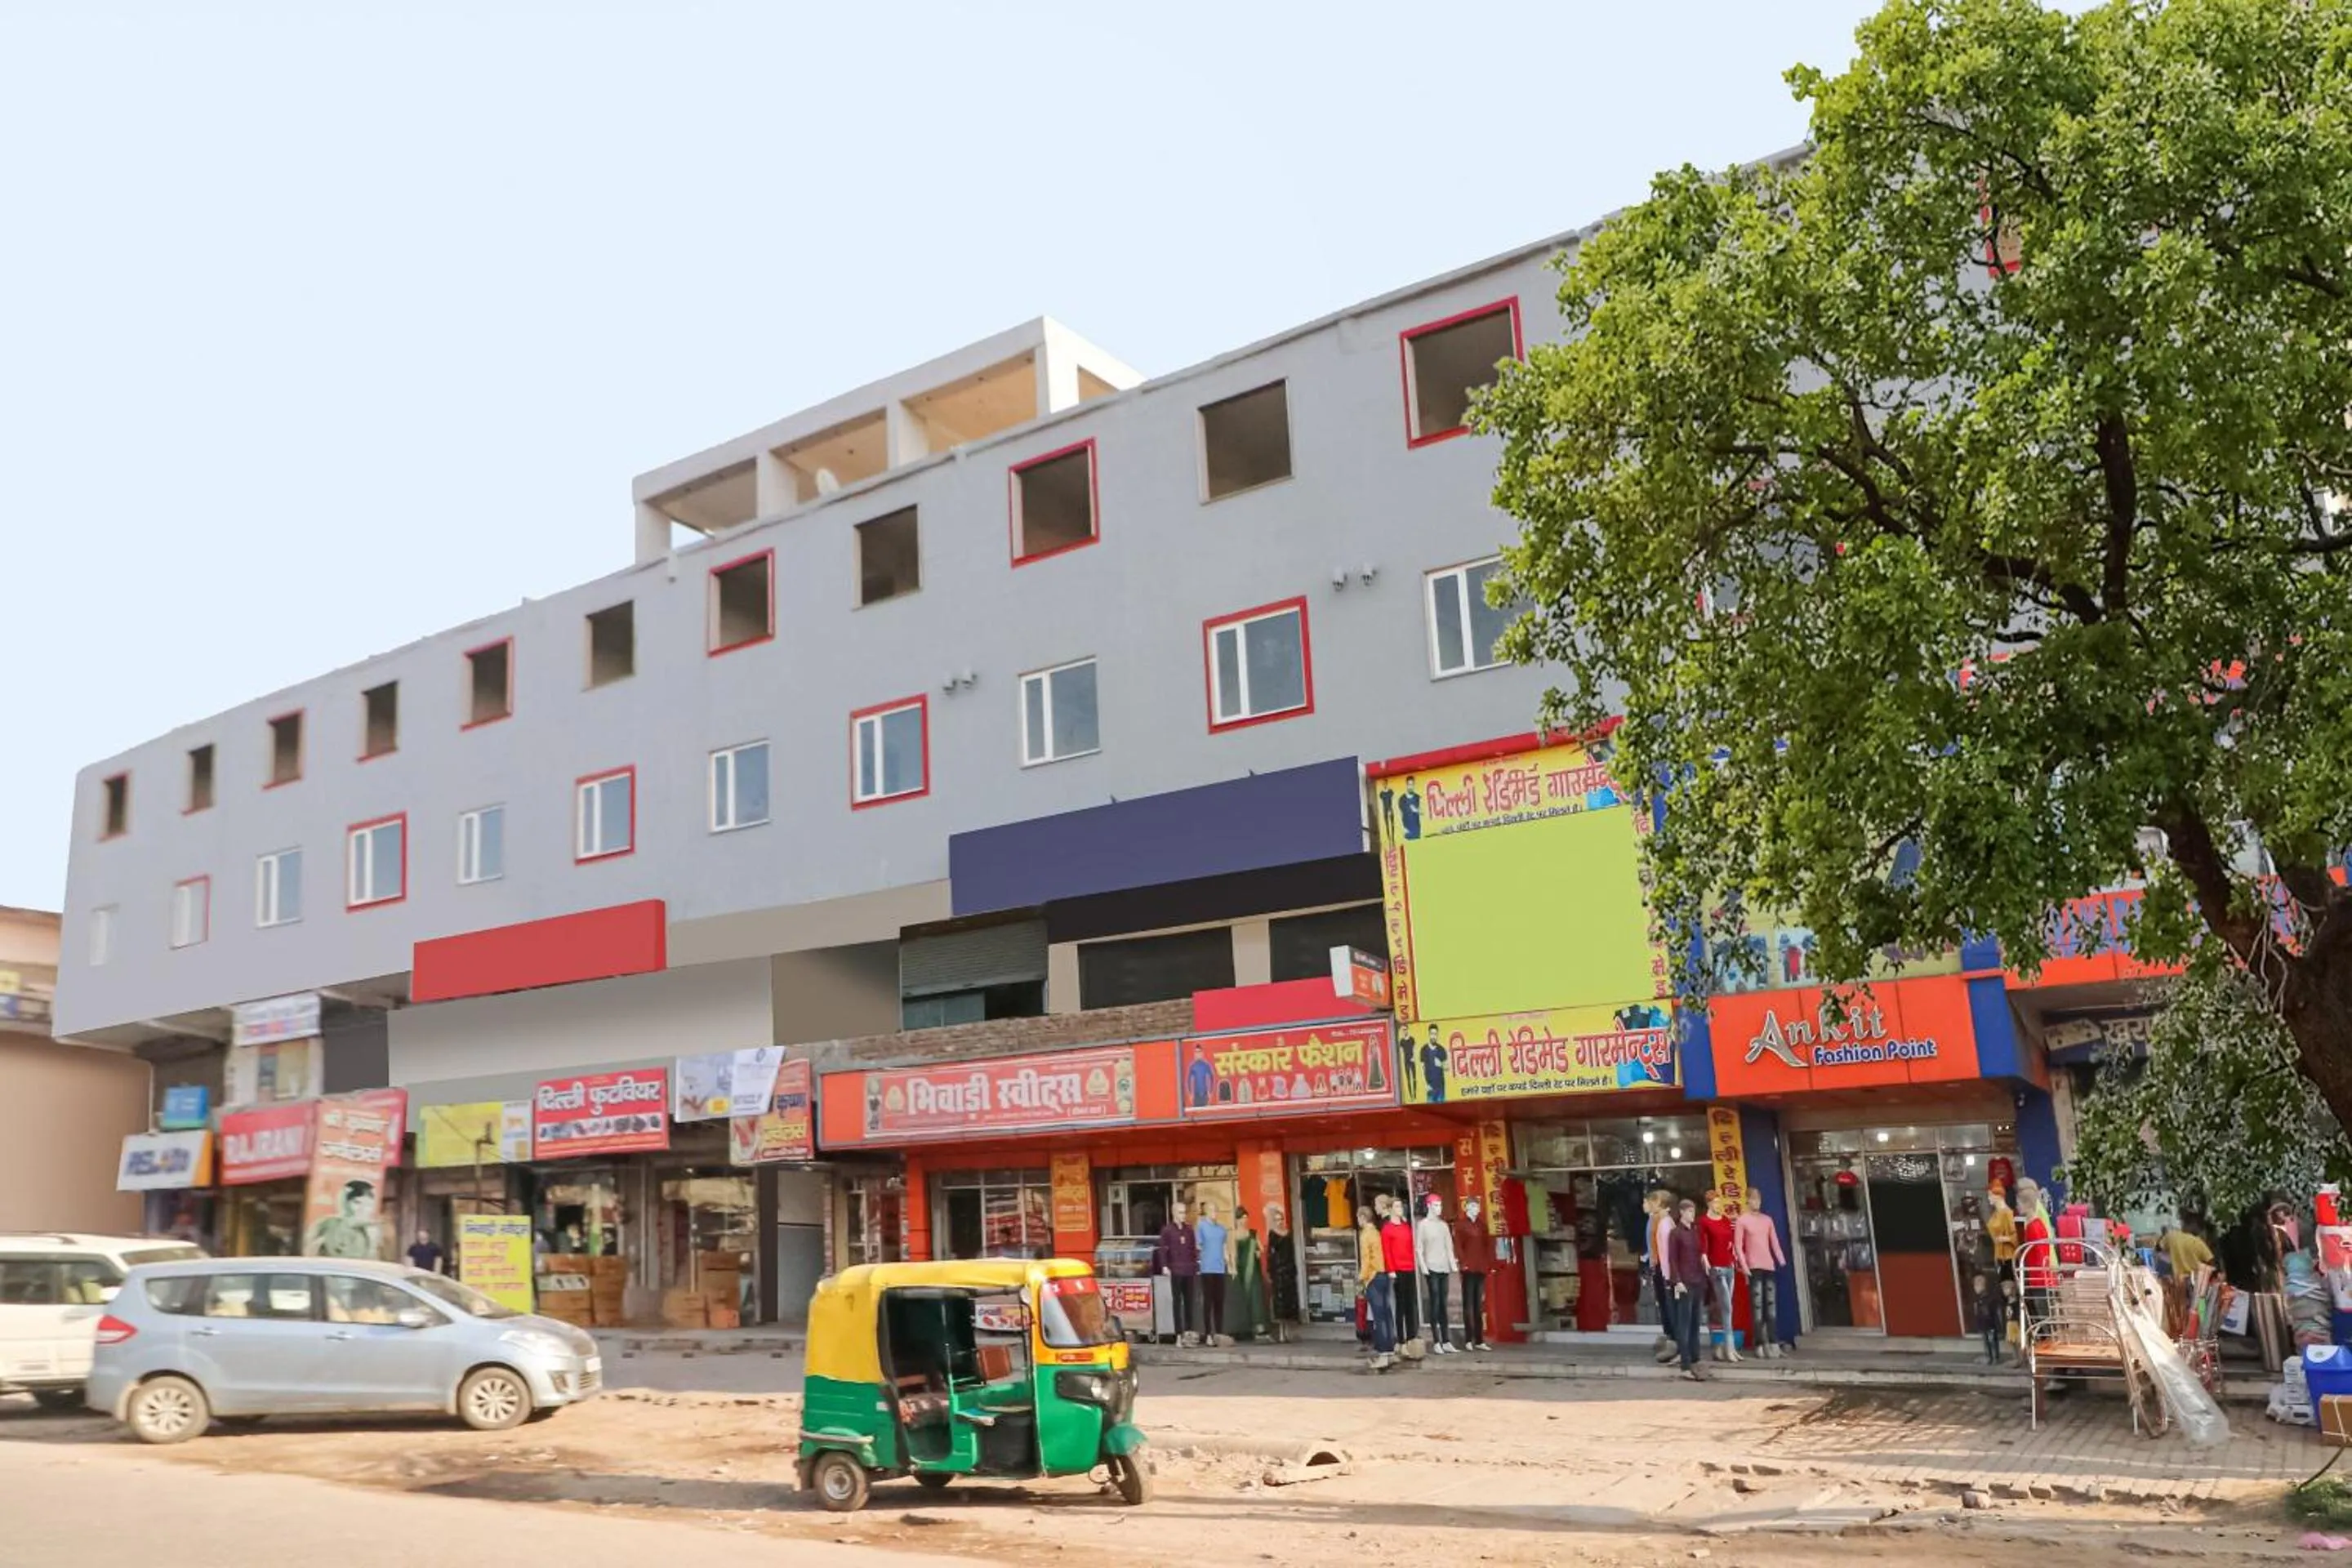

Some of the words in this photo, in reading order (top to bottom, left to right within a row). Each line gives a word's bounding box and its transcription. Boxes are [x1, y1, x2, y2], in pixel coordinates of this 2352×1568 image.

[1426, 774, 1477, 822] दिल्ली
[1447, 1028, 1503, 1080] दिल्ली
[1507, 1025, 1570, 1075] रेडिमेड
[1744, 1004, 1887, 1067] Ankit
[1814, 1045, 1883, 1066] Fashion
[1886, 1037, 1938, 1060] Point
[538, 1081, 585, 1111] दिल्ली
[906, 1072, 991, 1120] भिवाड़ी
[996, 1067, 1083, 1113] स्वीट्स
[1496, 1084, 1508, 1093] पर
[1528, 1078, 1552, 1091] दिल्ली
[1564, 1079, 1575, 1088] पर
